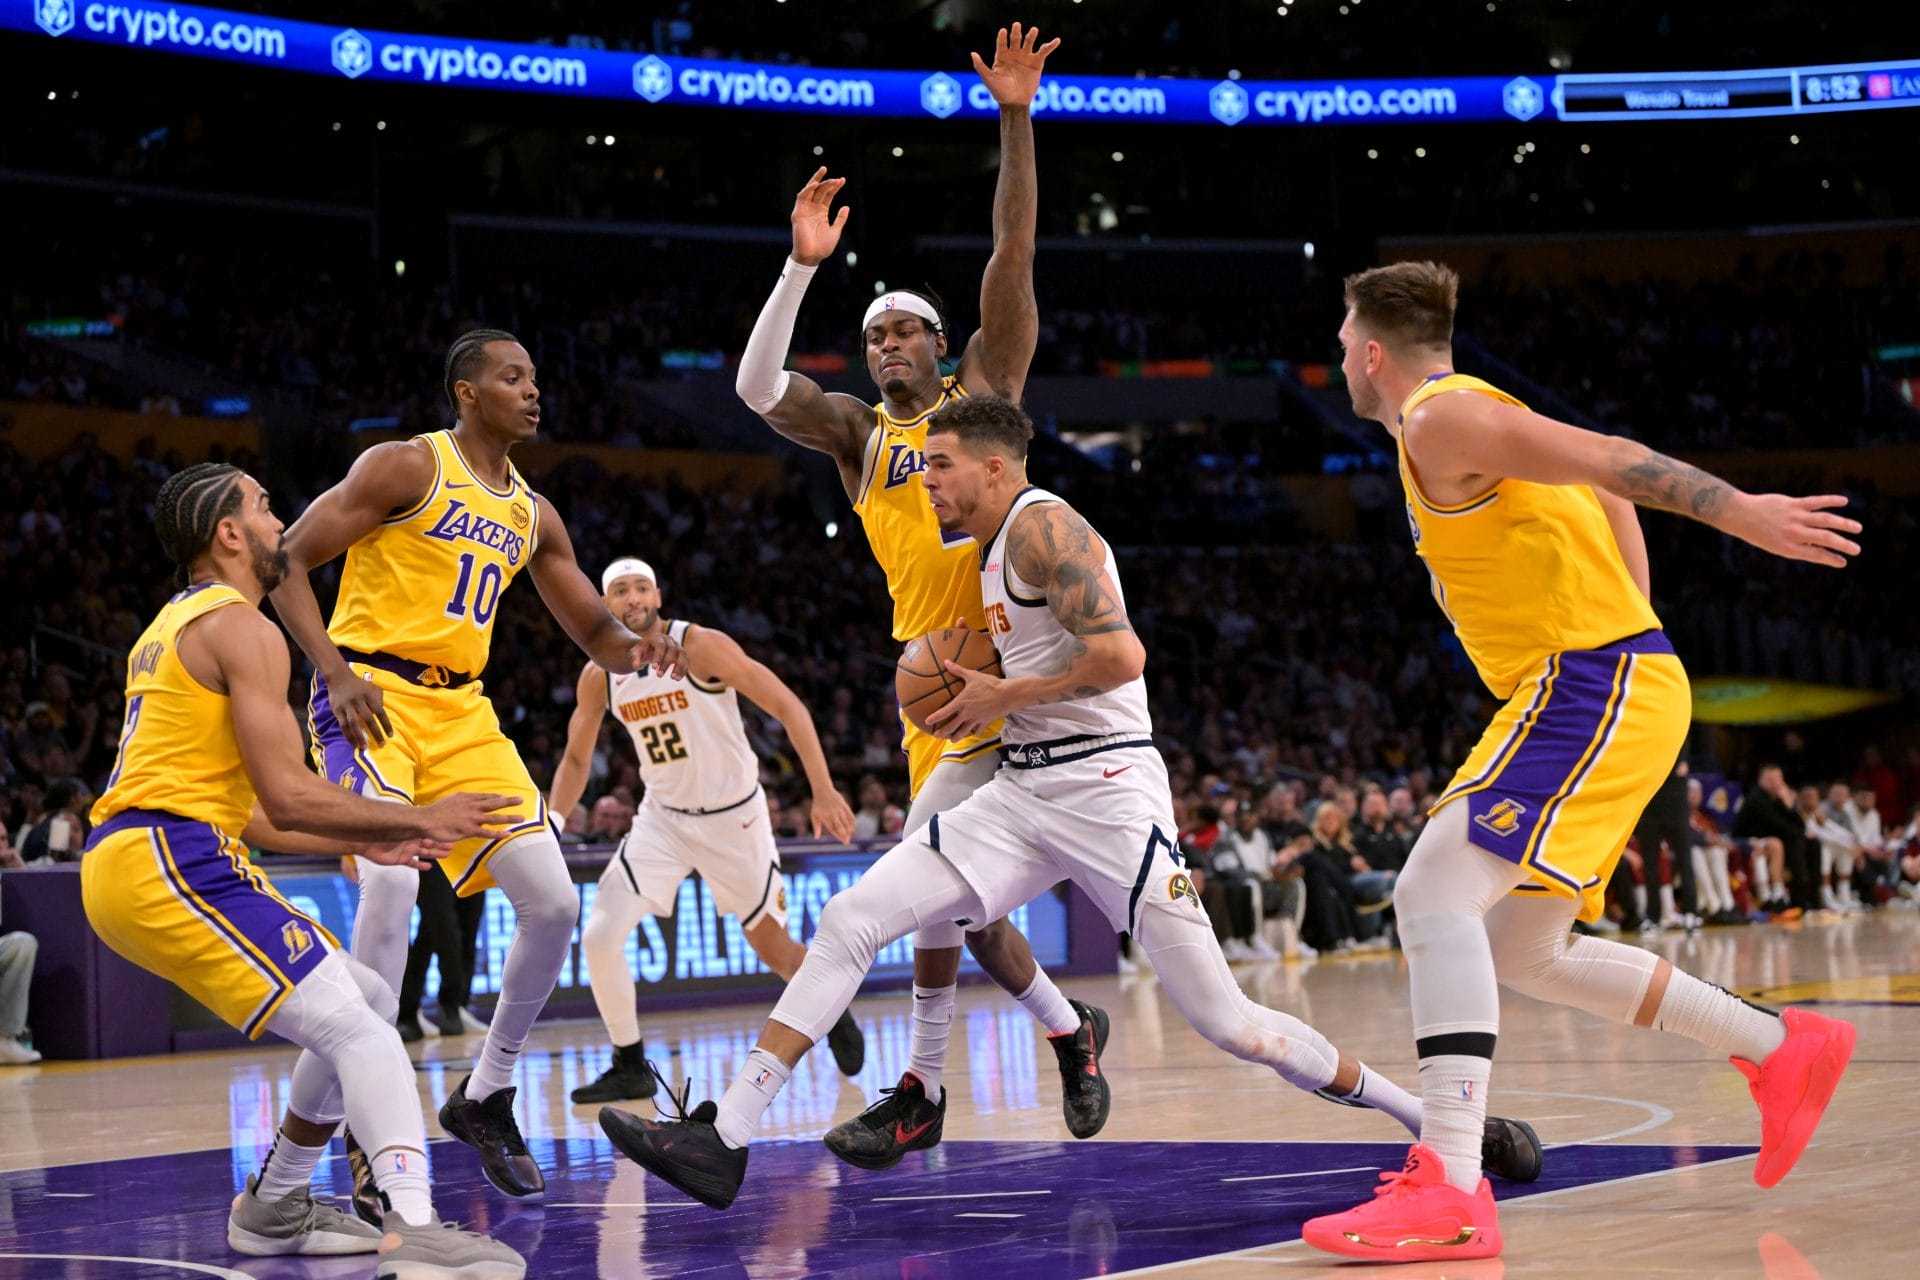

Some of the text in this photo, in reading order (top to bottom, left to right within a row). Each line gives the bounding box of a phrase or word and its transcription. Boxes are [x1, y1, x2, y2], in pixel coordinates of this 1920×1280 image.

[84, 2, 287, 59] crypto.com
[380, 43, 587, 87] crypto.com
[679, 68, 875, 107] crypto.com
[968, 80, 1166, 116] cpto.com
[1254, 84, 1457, 122] crypto.com
[424, 499, 525, 566] LAKERS
[444, 552, 502, 627] 10
[618, 689, 690, 724] NUGGETS
[640, 721, 688, 765] 22
